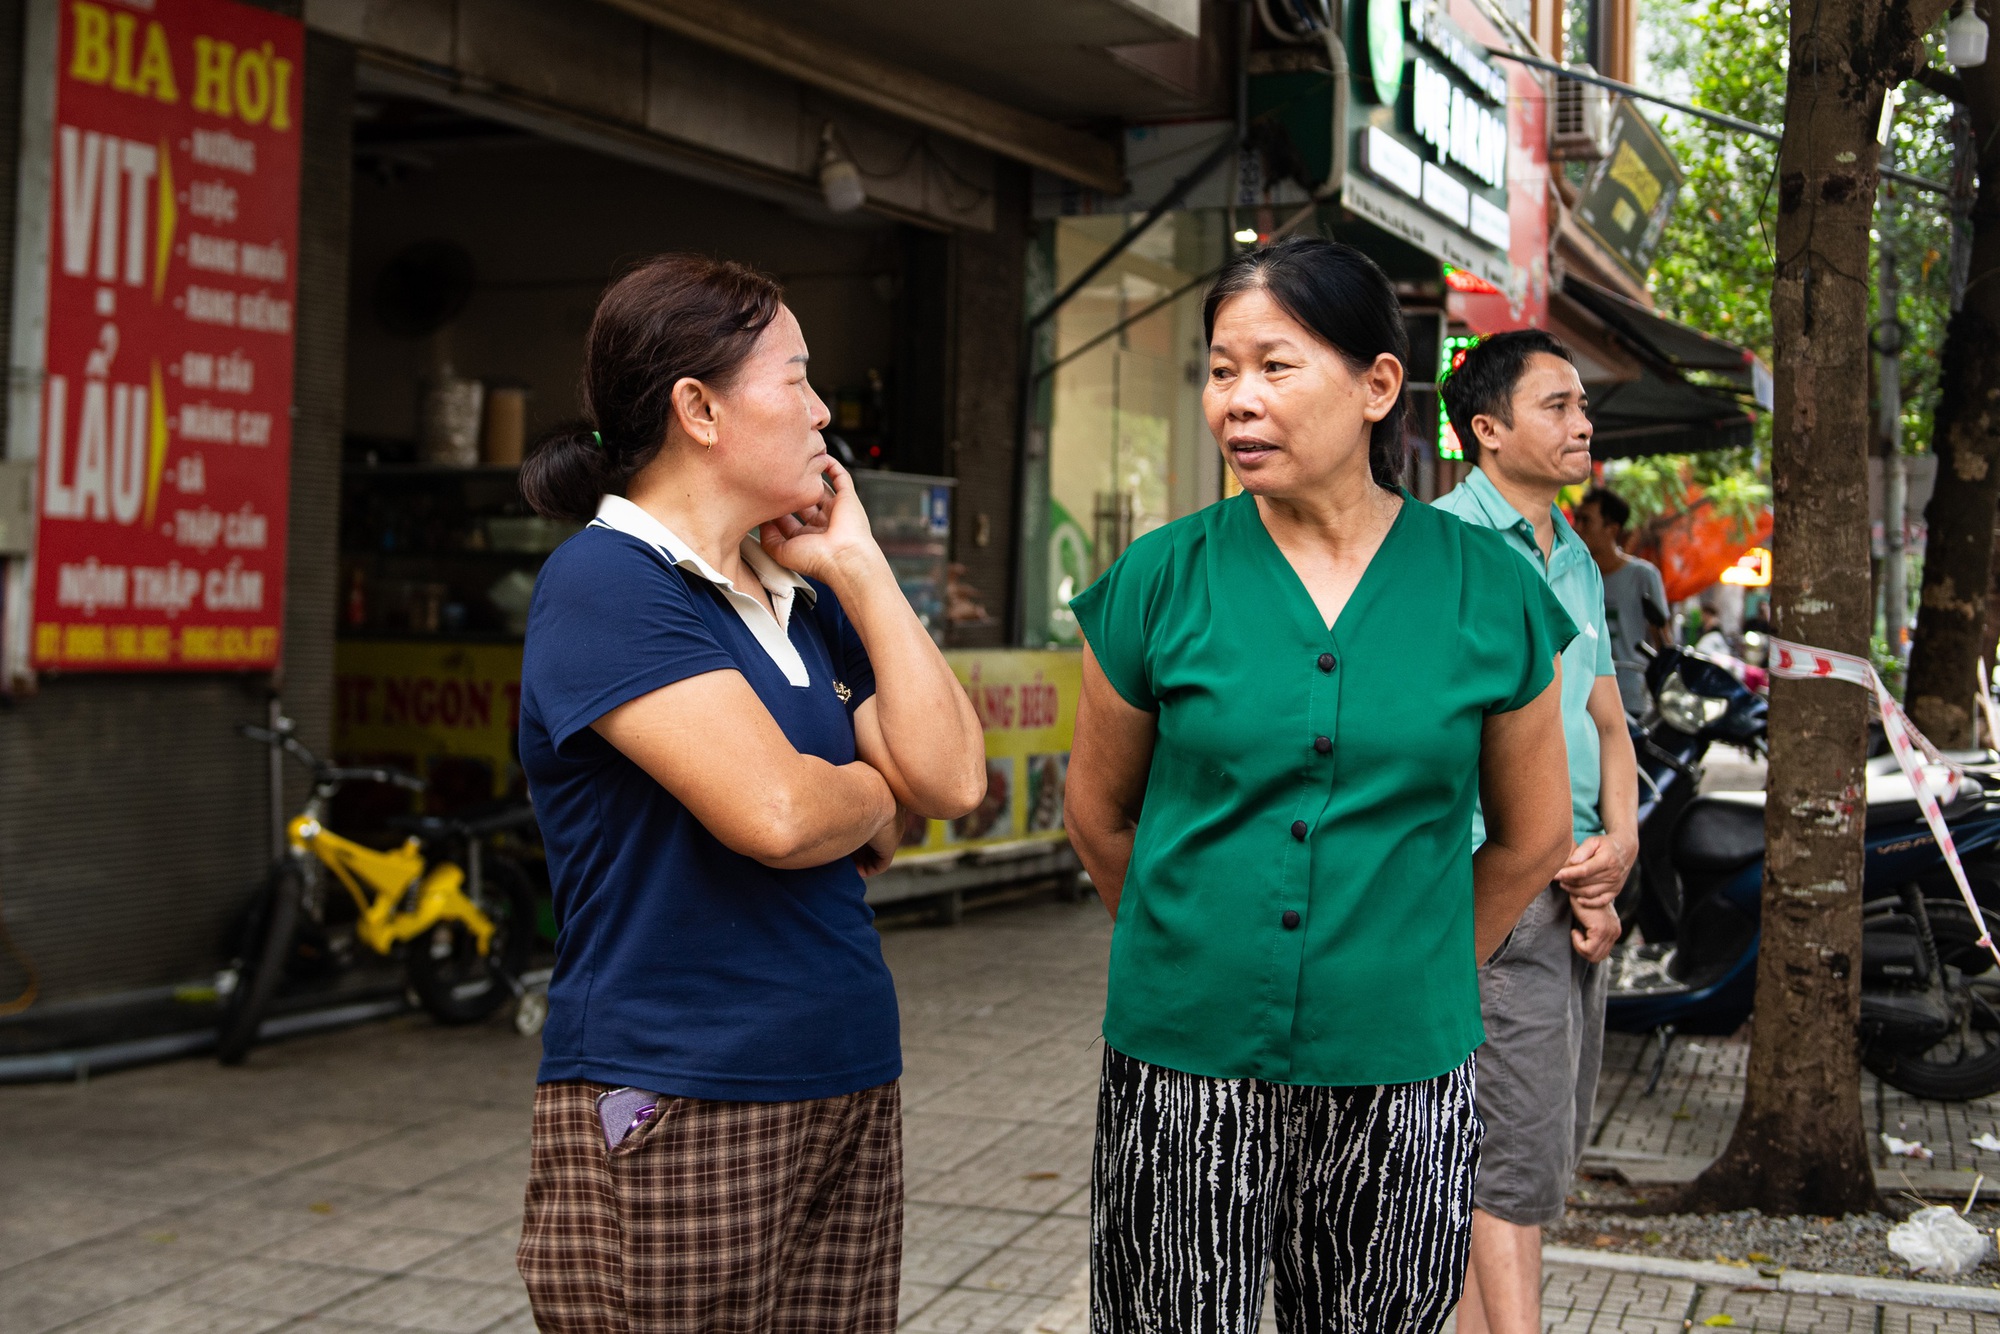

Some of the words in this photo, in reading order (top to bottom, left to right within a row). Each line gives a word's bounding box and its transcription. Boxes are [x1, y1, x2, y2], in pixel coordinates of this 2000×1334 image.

[70, 2, 179, 105] BIA
[192, 36, 292, 131] HƠI
[60, 124, 156, 316] VỊT
[44, 322, 149, 526] LẨU
[383, 675, 494, 730] NGON
[1018, 669, 1060, 730] BÉO
